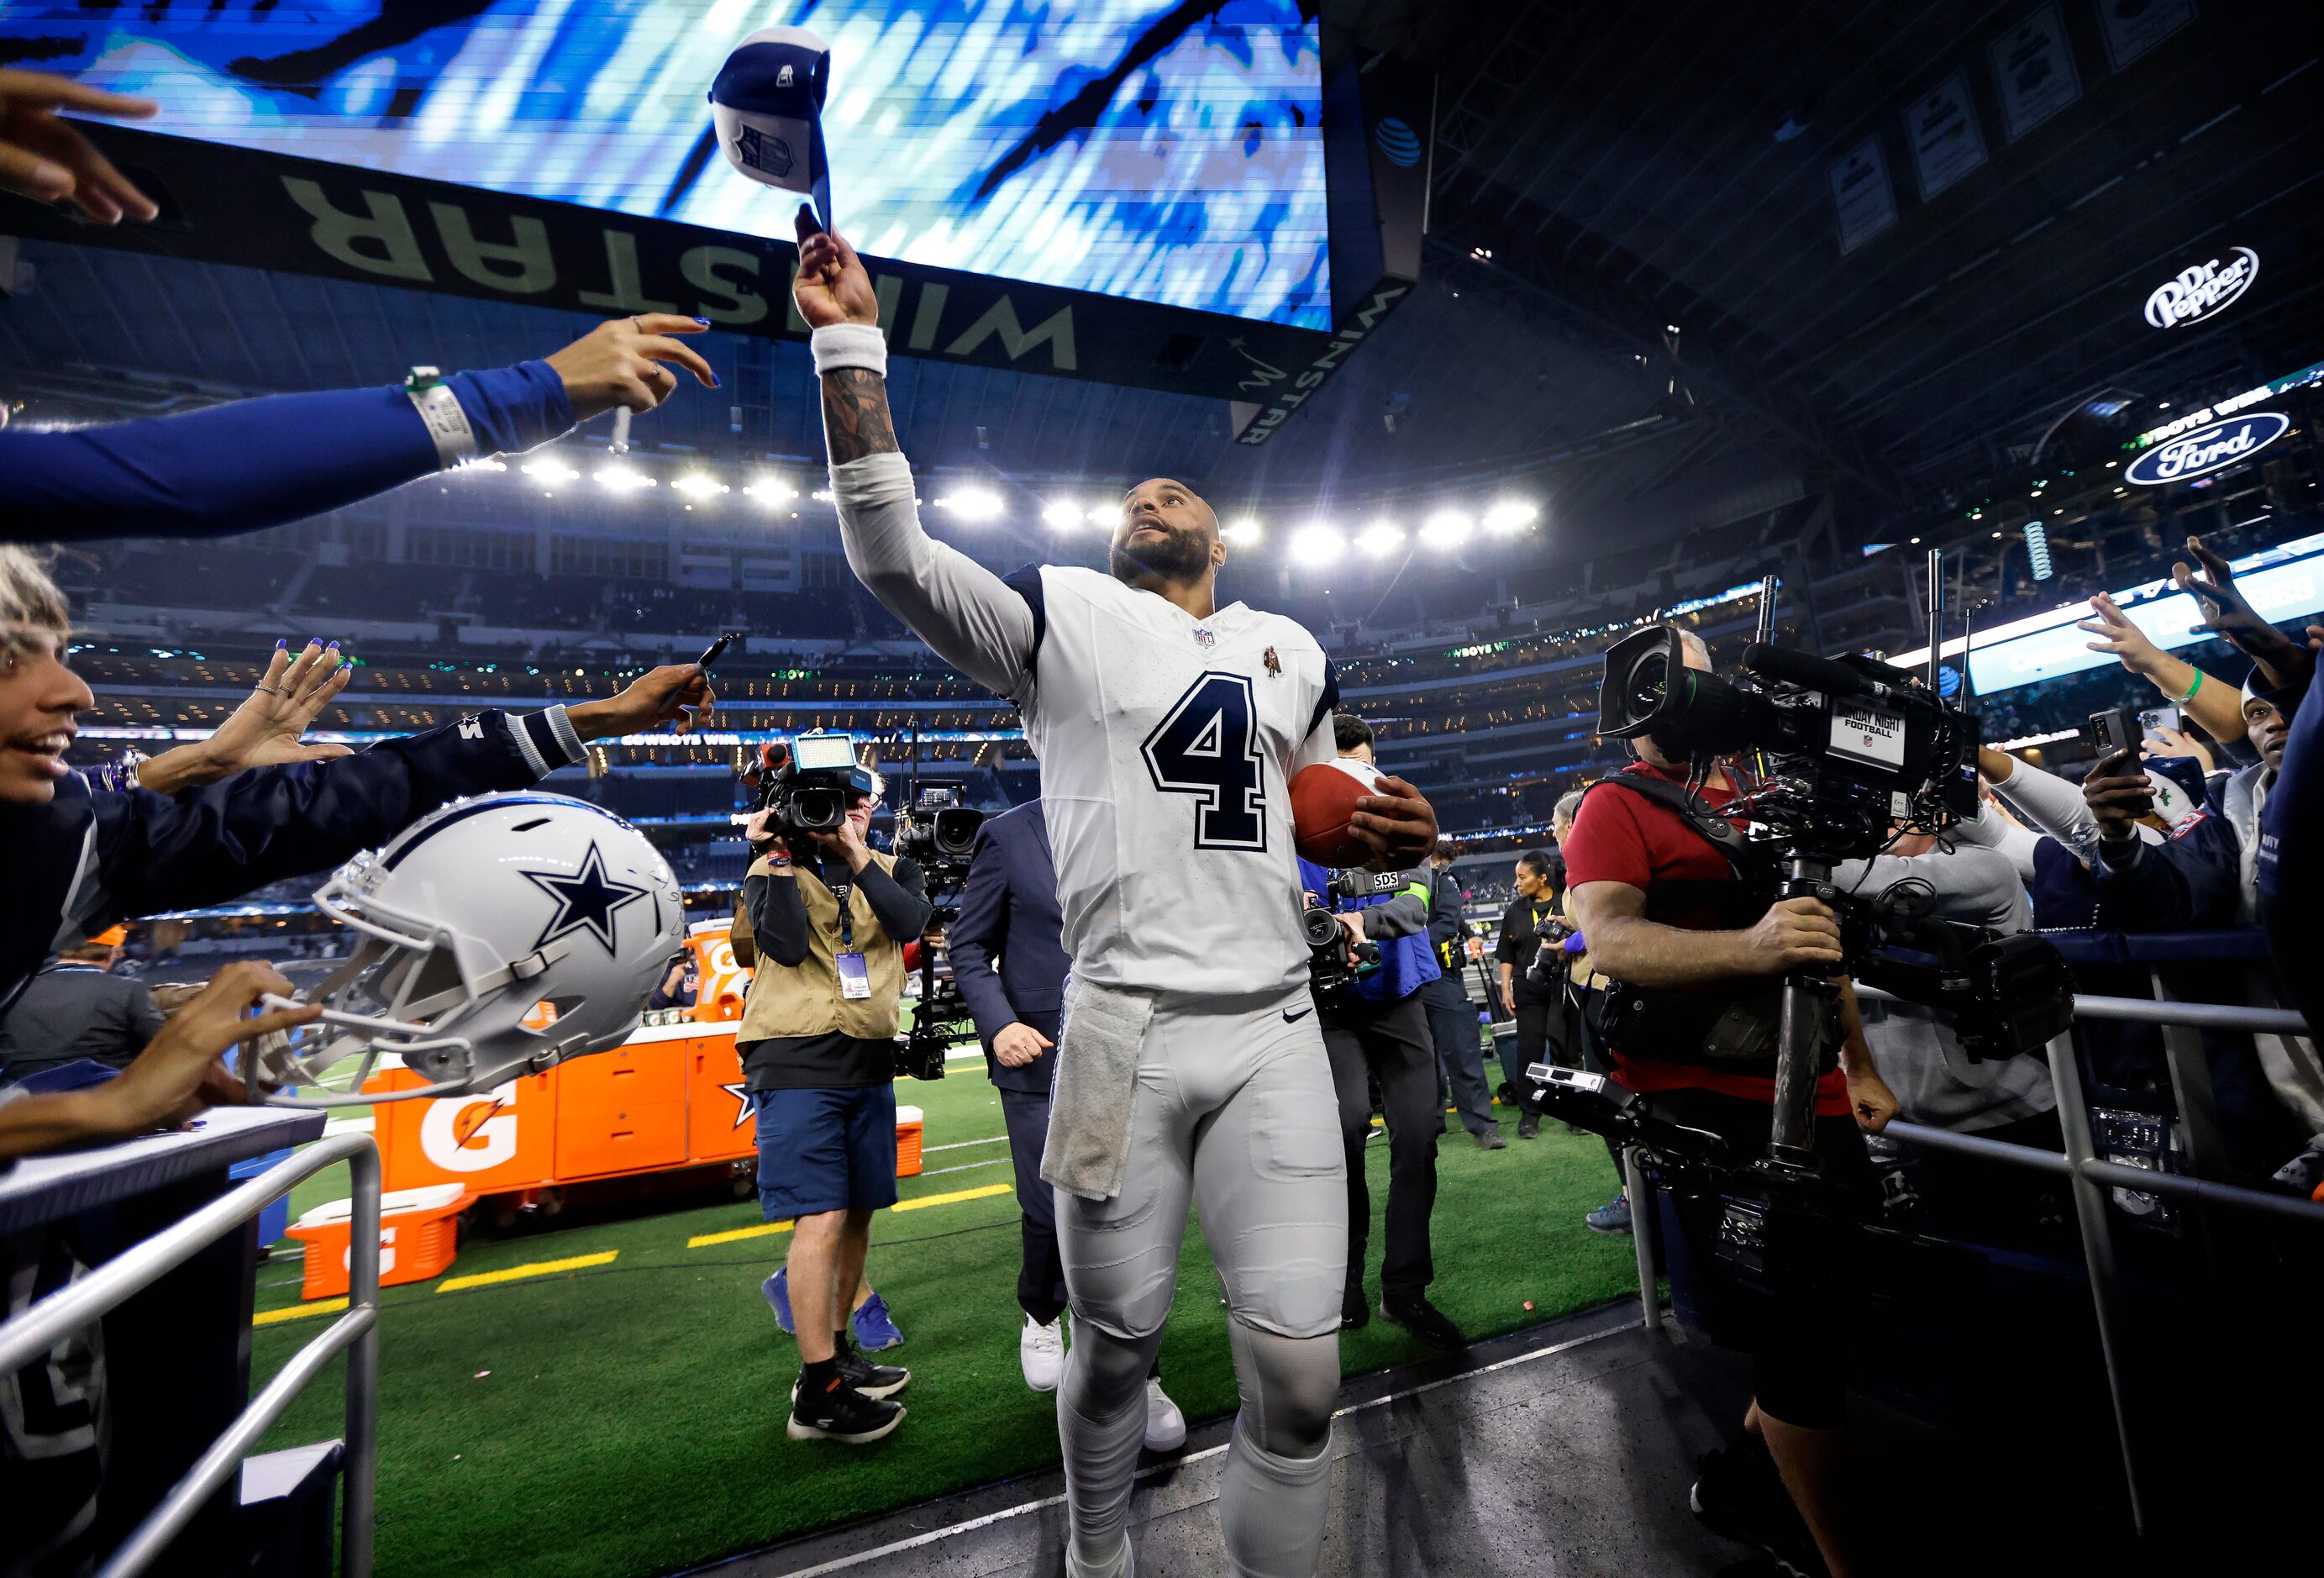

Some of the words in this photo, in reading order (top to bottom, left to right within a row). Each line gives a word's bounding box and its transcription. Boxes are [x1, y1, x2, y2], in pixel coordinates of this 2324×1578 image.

[2144, 255, 2250, 329] Pepper
[2176, 259, 2219, 297] Dr
[1239, 285, 1410, 444] WINSTAR
[2157, 424, 2256, 477] Ford
[1197, 634, 1212, 644] NFL
[1837, 705, 1873, 724] SUNDAY
[1875, 712, 1901, 732] NIGHT
[1844, 718, 1892, 739] FOOTBALL
[621, 734, 701, 745] COWBOYS
[1140, 671, 1267, 852] 4
[1375, 872, 1397, 886] SDS
[421, 1079, 518, 1172] G
